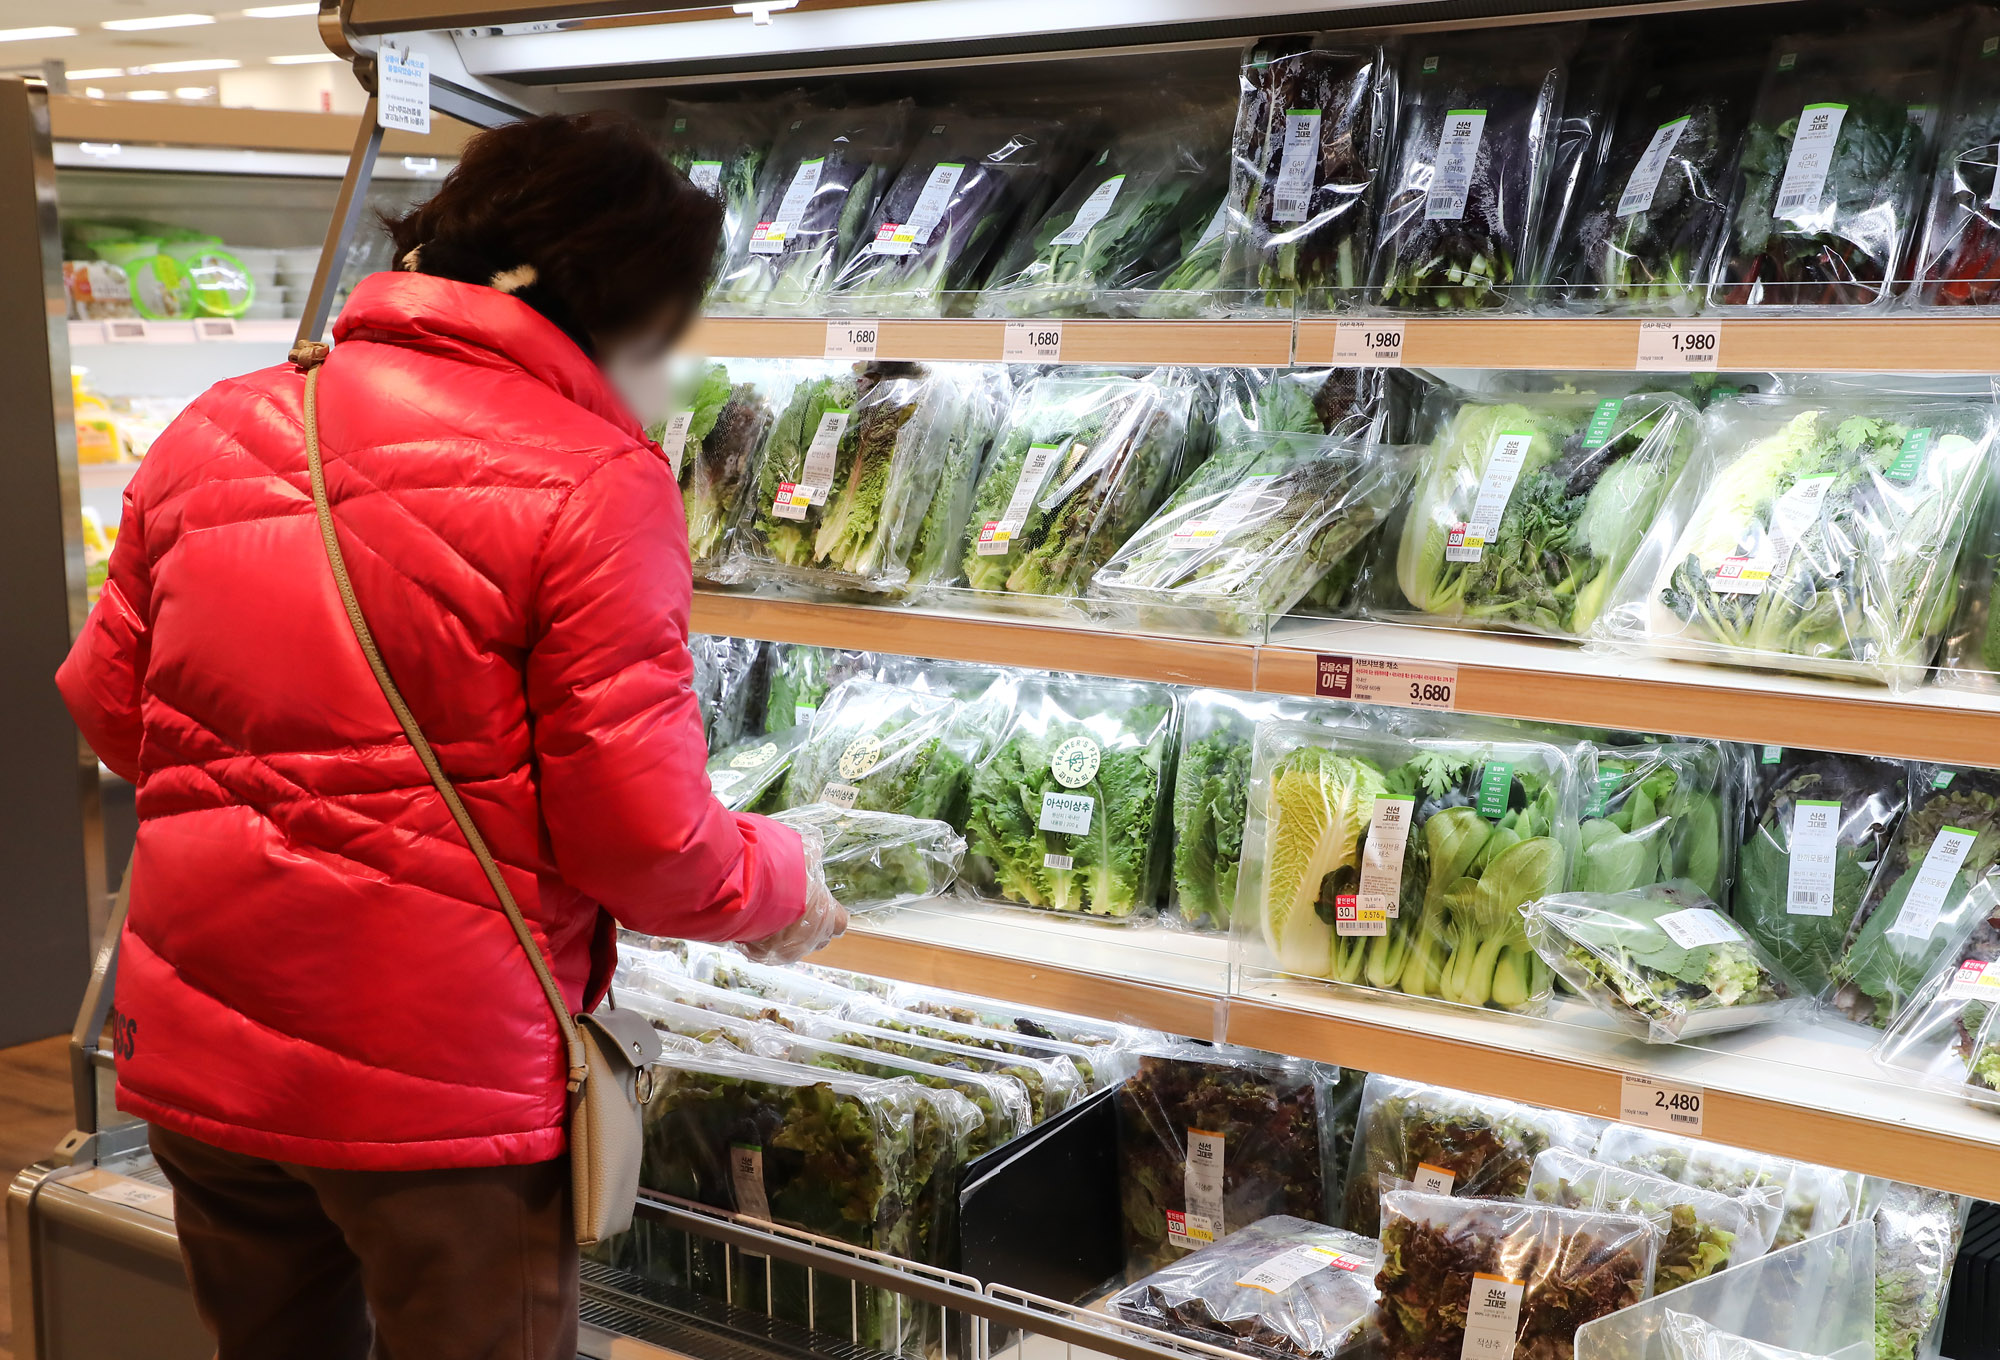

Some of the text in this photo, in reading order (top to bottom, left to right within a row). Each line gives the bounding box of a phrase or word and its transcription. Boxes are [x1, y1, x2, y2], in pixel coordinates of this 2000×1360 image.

[1813, 114, 1829, 123] 신선
[1297, 122, 1310, 130] 신선
[1808, 123, 1829, 131] 그대로
[1295, 130, 1311, 138] 그대로
[848, 330, 875, 344] 1,680
[1028, 332, 1059, 347] 1,680
[1364, 332, 1401, 349] 1,980
[1672, 334, 1715, 352] 1,980
[1502, 448, 1518, 456] 그대로
[1320, 661, 1350, 674] 담을수록
[1355, 659, 1399, 669] 샤브샤브용 채소
[1322, 673, 1348, 690] 이득
[1410, 683, 1451, 702] 3,680
[1055, 739, 1098, 770] FARMER'S PICK
[1058, 771, 1089, 785] 파머스픽
[825, 787, 855, 802] 아삭이상추
[1046, 798, 1090, 813] 아삭이상추
[1386, 806, 1400, 814] 신선
[1383, 814, 1400, 822] 그대로
[1810, 812, 1826, 821] 신선
[1807, 820, 1827, 829] 그대로
[1946, 839, 1961, 848] 신선
[1940, 846, 1958, 855] 그대로
[1337, 897, 1355, 905] 할인판매
[1963, 961, 1986, 970] 할인판매
[1655, 1090, 1700, 1111] 2,480
[1198, 1142, 1212, 1151] 신선
[1197, 1150, 1213, 1159] 그대로
[1427, 1178, 1441, 1189] 신선
[1488, 1288, 1506, 1300] 신선
[1484, 1299, 1507, 1309] 그대로
[1477, 1337, 1502, 1350] 적상추
